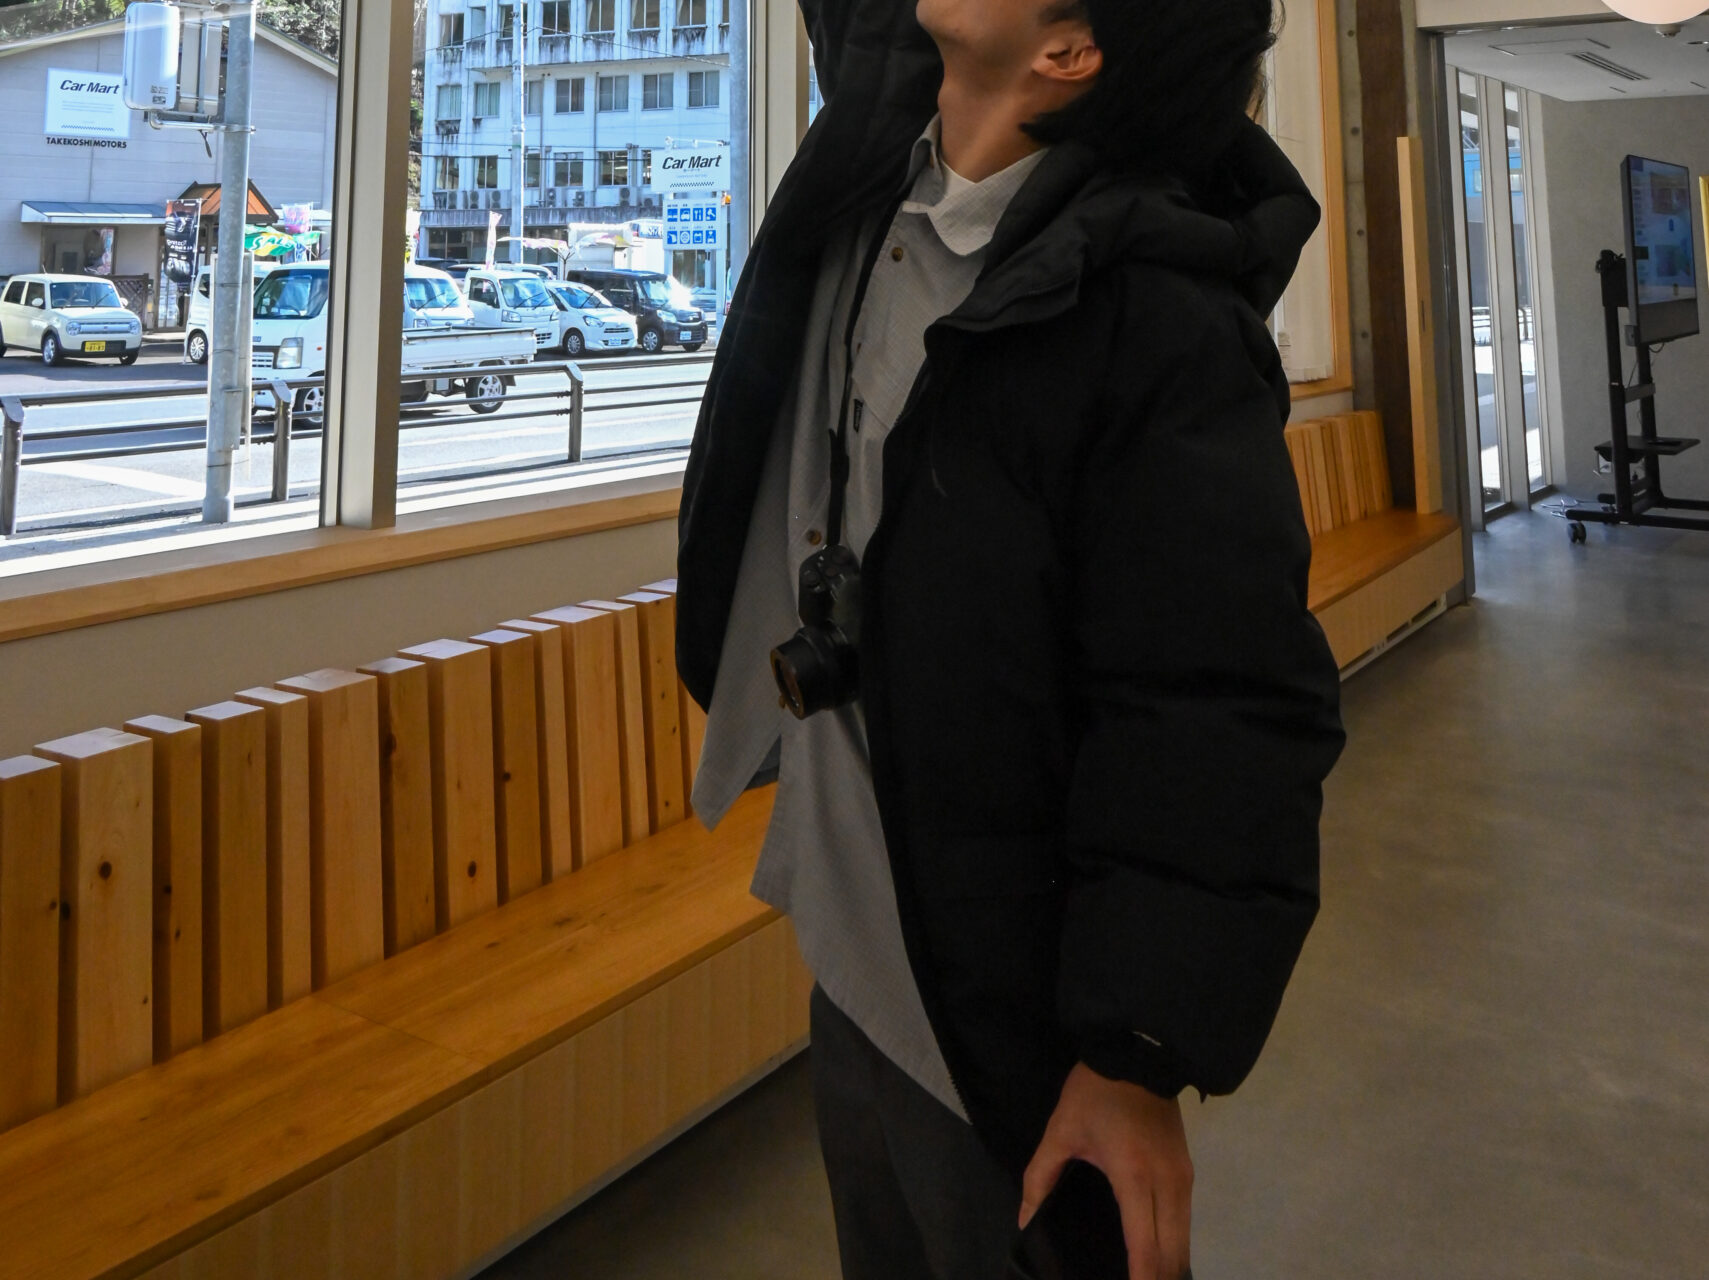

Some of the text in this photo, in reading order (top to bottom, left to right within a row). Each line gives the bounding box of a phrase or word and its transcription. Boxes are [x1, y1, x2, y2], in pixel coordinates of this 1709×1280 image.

[60, 79, 120, 95] Car Mart
[46, 136, 127, 149] TAKEKOSHI MOTORS
[662, 157, 687, 170] Car
[688, 154, 722, 169] Mart
